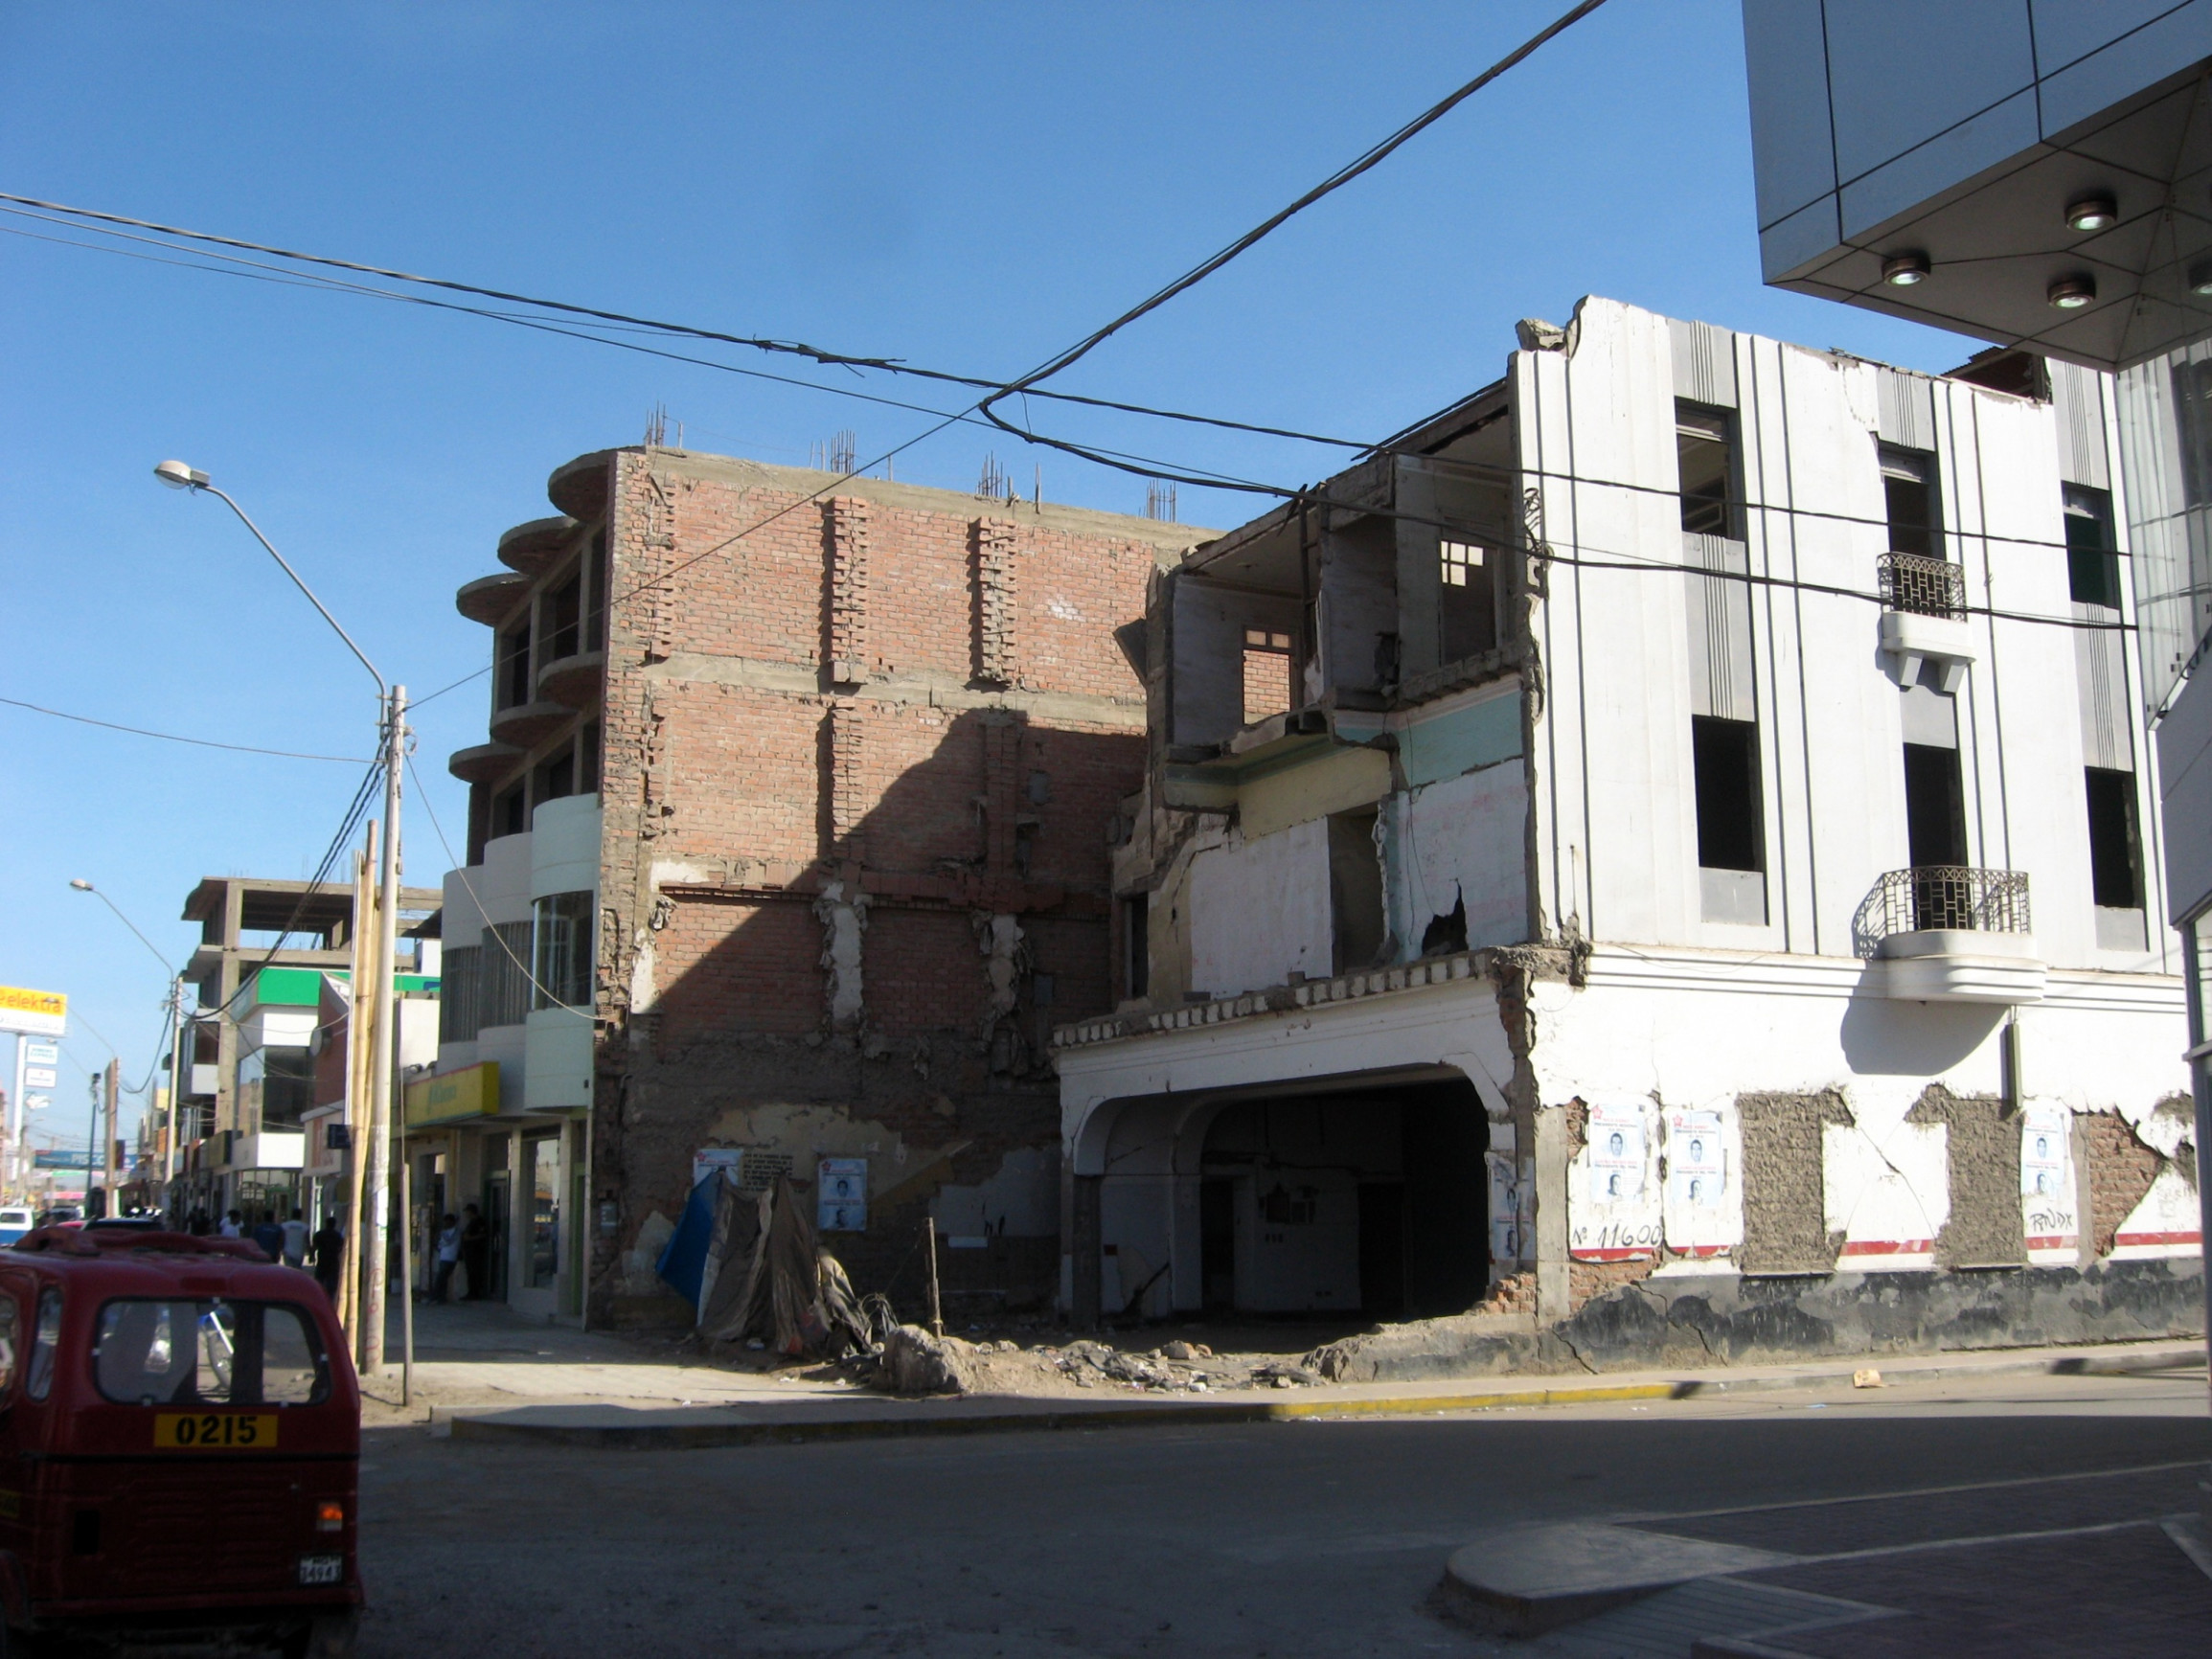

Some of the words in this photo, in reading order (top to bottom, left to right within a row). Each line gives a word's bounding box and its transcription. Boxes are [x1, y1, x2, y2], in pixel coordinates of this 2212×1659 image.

[7, 991, 62, 1013] elektra
[1598, 1223, 1662, 1249] 11600
[176, 1416, 257, 1444] 0215
